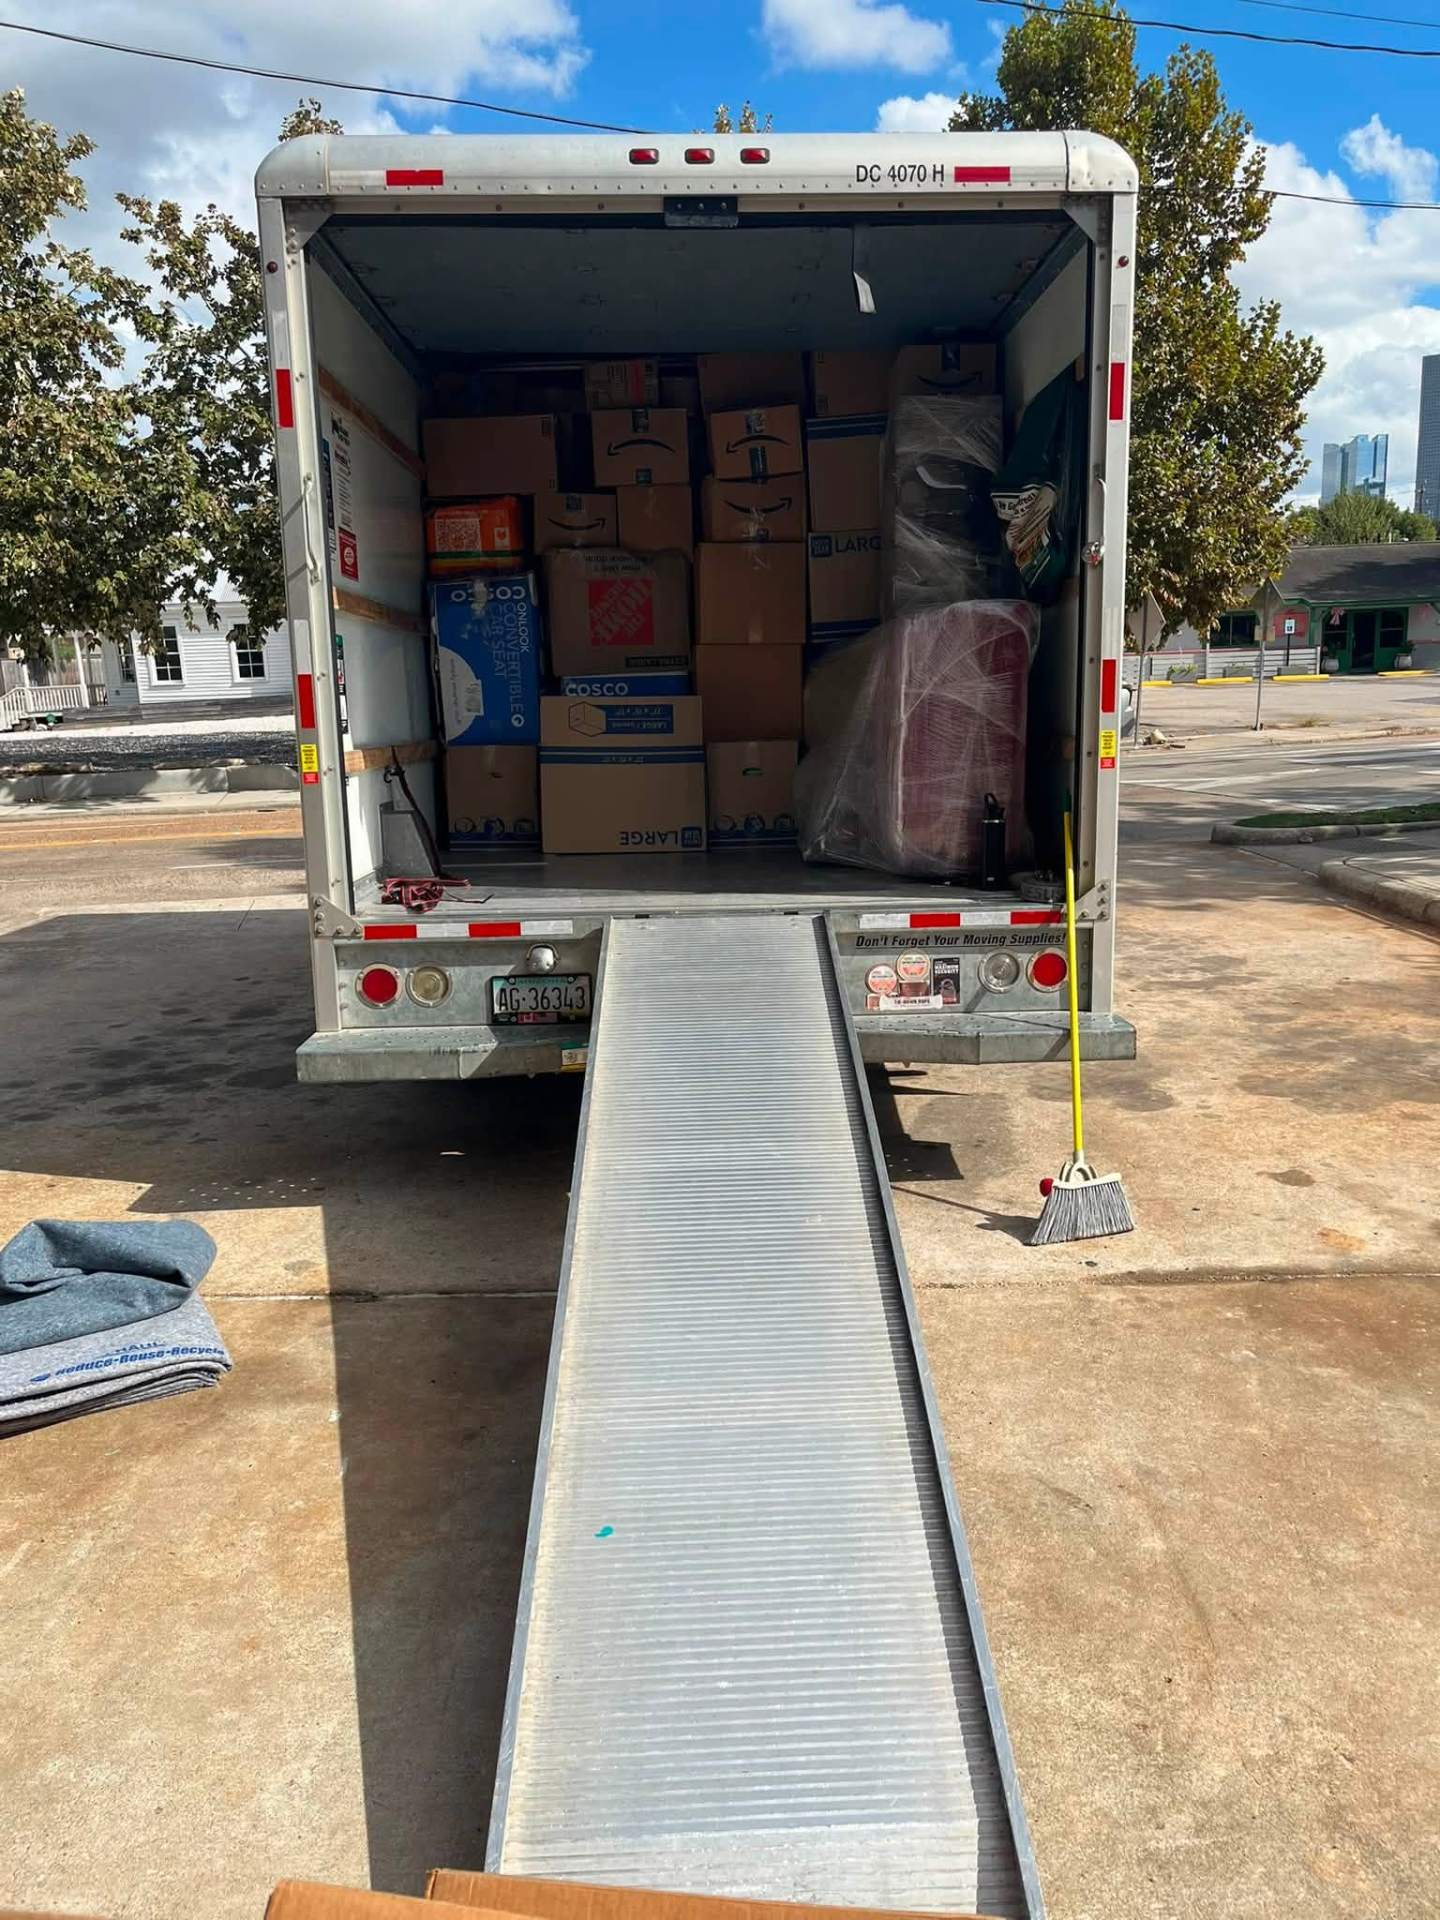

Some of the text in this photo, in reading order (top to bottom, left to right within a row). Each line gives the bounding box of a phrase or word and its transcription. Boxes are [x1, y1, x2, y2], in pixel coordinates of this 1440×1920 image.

[856, 164, 945, 182] DC 4070 H
[835, 535, 881, 552] LARG
[516, 602, 530, 654] ONLOOK
[492, 639, 508, 681] SEAT
[503, 602, 524, 713] CONVERTIBLE
[565, 682, 629, 697] COSCO
[619, 830, 678, 846] LARGE
[856, 932, 1067, 948] Don't Forget Your Moving Supplies!
